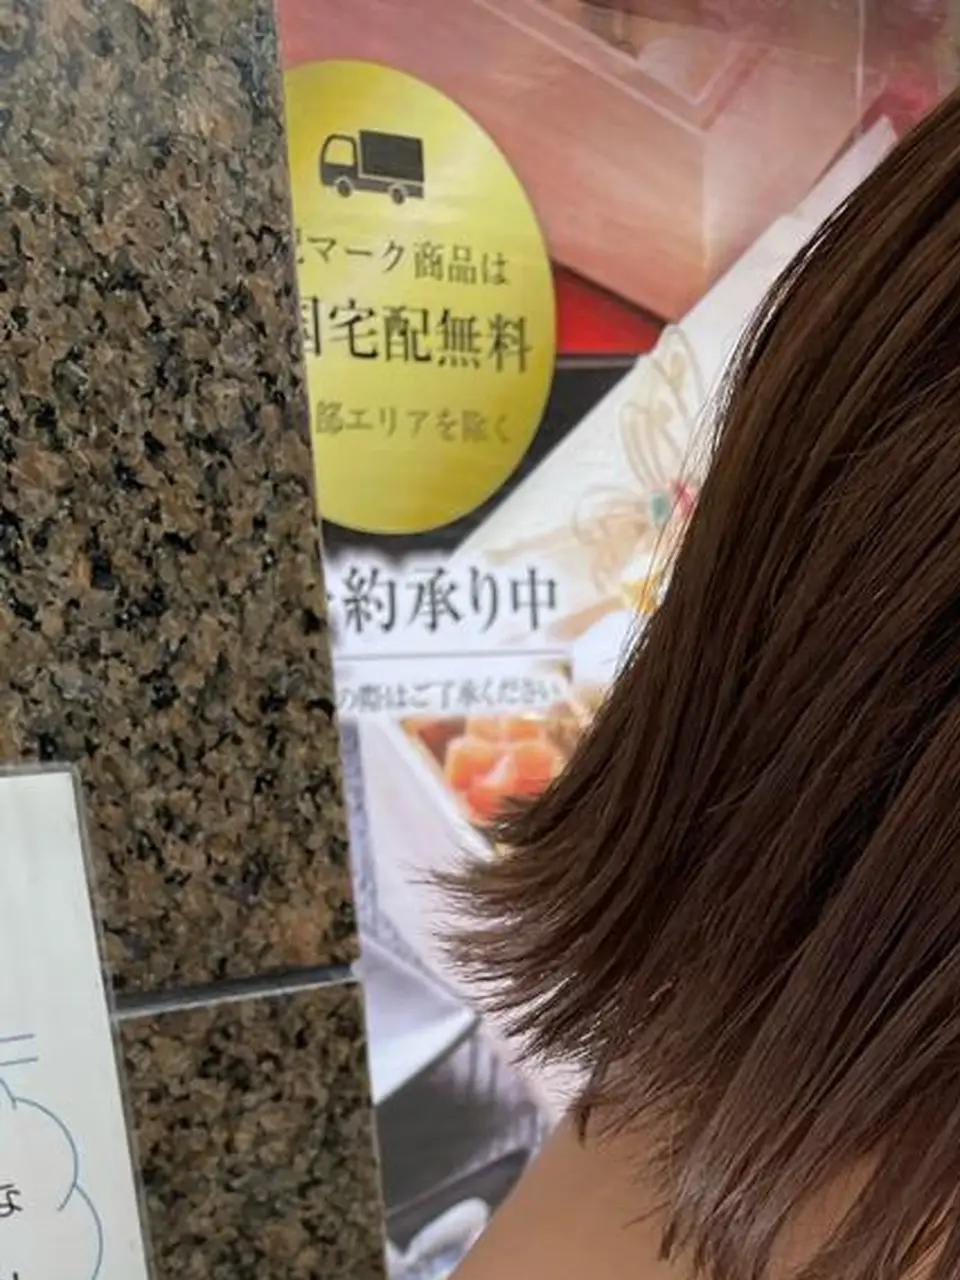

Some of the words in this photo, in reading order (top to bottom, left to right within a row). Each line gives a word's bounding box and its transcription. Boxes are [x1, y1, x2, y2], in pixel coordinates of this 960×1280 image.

[297, 227, 508, 286] マーク商品は
[327, 566, 556, 634] 約承り中
